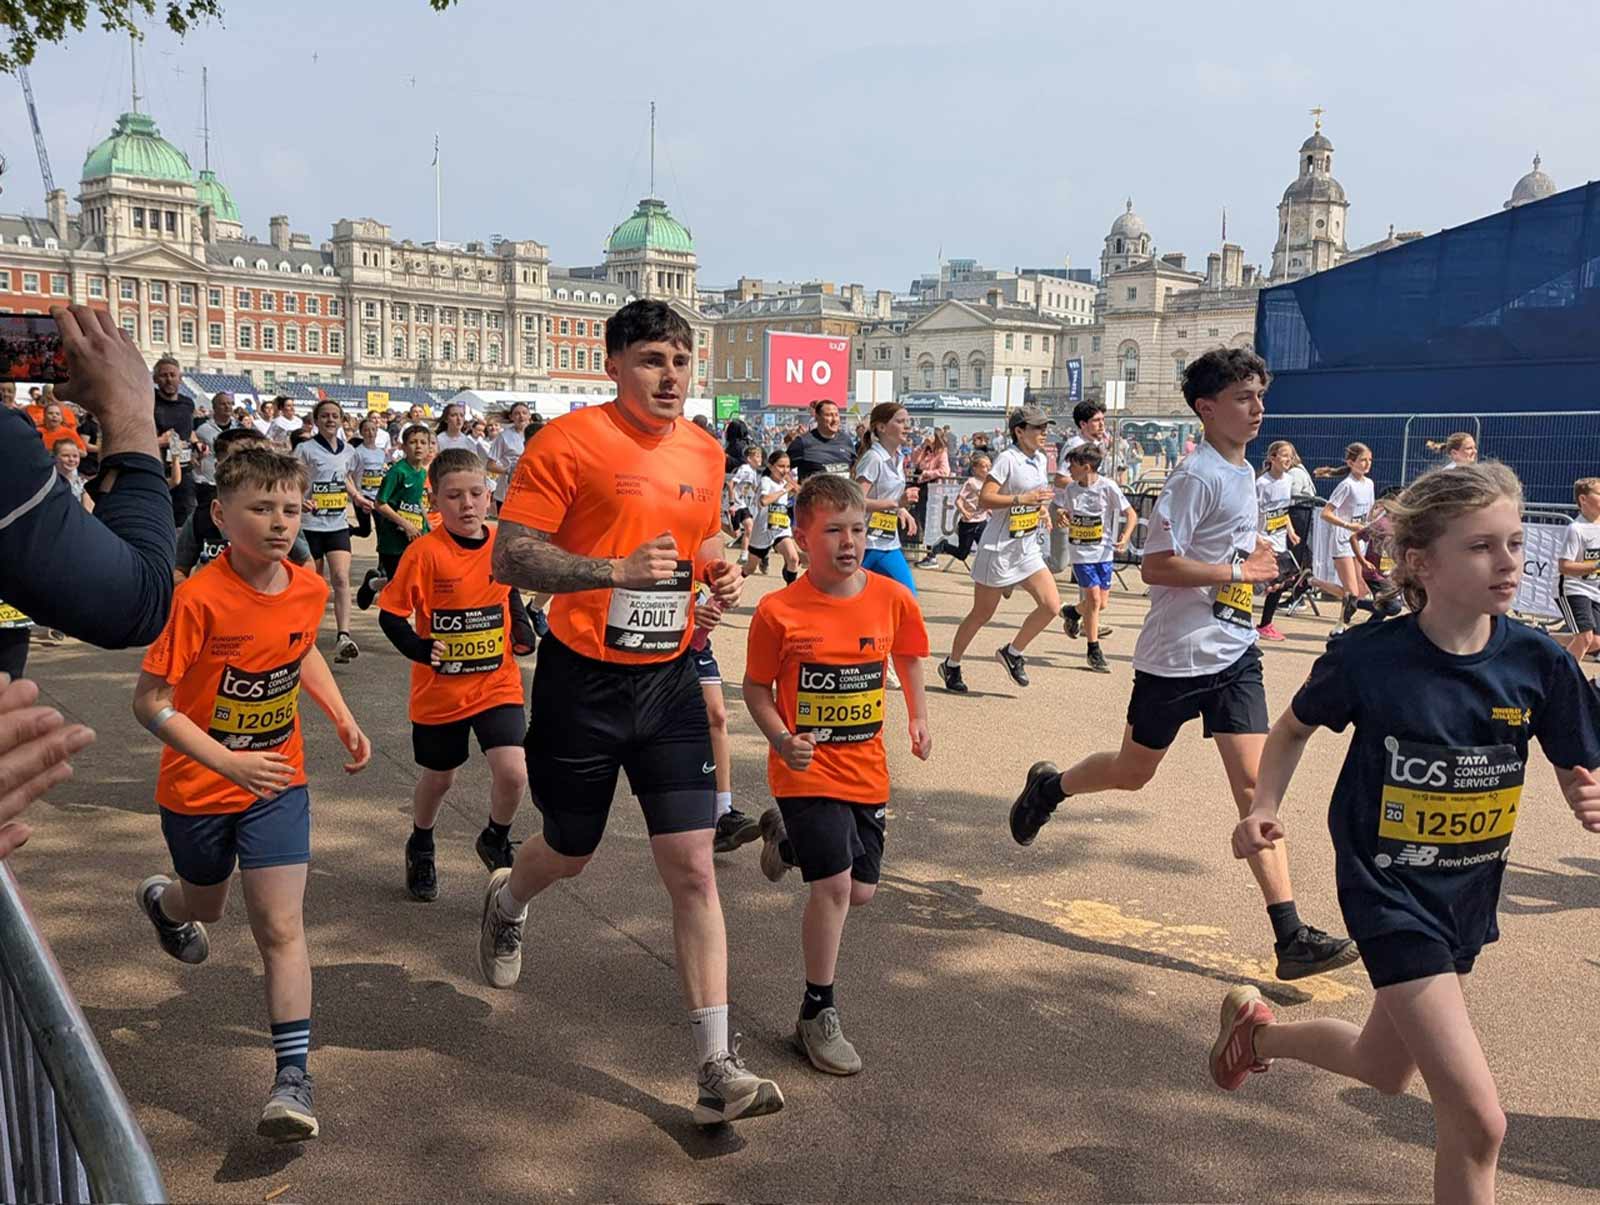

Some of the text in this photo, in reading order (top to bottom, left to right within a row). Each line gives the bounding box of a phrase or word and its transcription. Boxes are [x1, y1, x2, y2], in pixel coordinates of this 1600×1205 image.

[786, 358, 831, 385] NO
[1523, 560, 1547, 576] CY
[629, 600, 678, 609] ACCOMPANYING
[433, 611, 463, 631] tcs
[465, 613, 502, 624] CONSULTANCY
[627, 609, 676, 627] ADULT
[465, 622, 491, 630] SERVICES
[447, 640, 496, 657] 12059
[270, 668, 288, 680] TATA
[476, 664, 498, 672] balance
[223, 668, 265, 698] tcs
[801, 667, 835, 690] tcs
[839, 671, 881, 682] CONSULTANCY
[267, 681, 294, 696] SERVICES
[839, 681, 868, 690] SERVICES
[237, 702, 293, 729] 12056
[816, 703, 872, 722] 12058
[848, 731, 874, 741] balance
[251, 741, 268, 749] new
[1455, 756, 1489, 765] TATA
[1391, 750, 1448, 787] tcs
[1454, 761, 1523, 777] CONSULTANCY
[1453, 776, 1500, 788] SERVICES
[1386, 809, 1402, 821] 20
[1415, 808, 1503, 837] 12507
[1438, 851, 1500, 868] new balance
